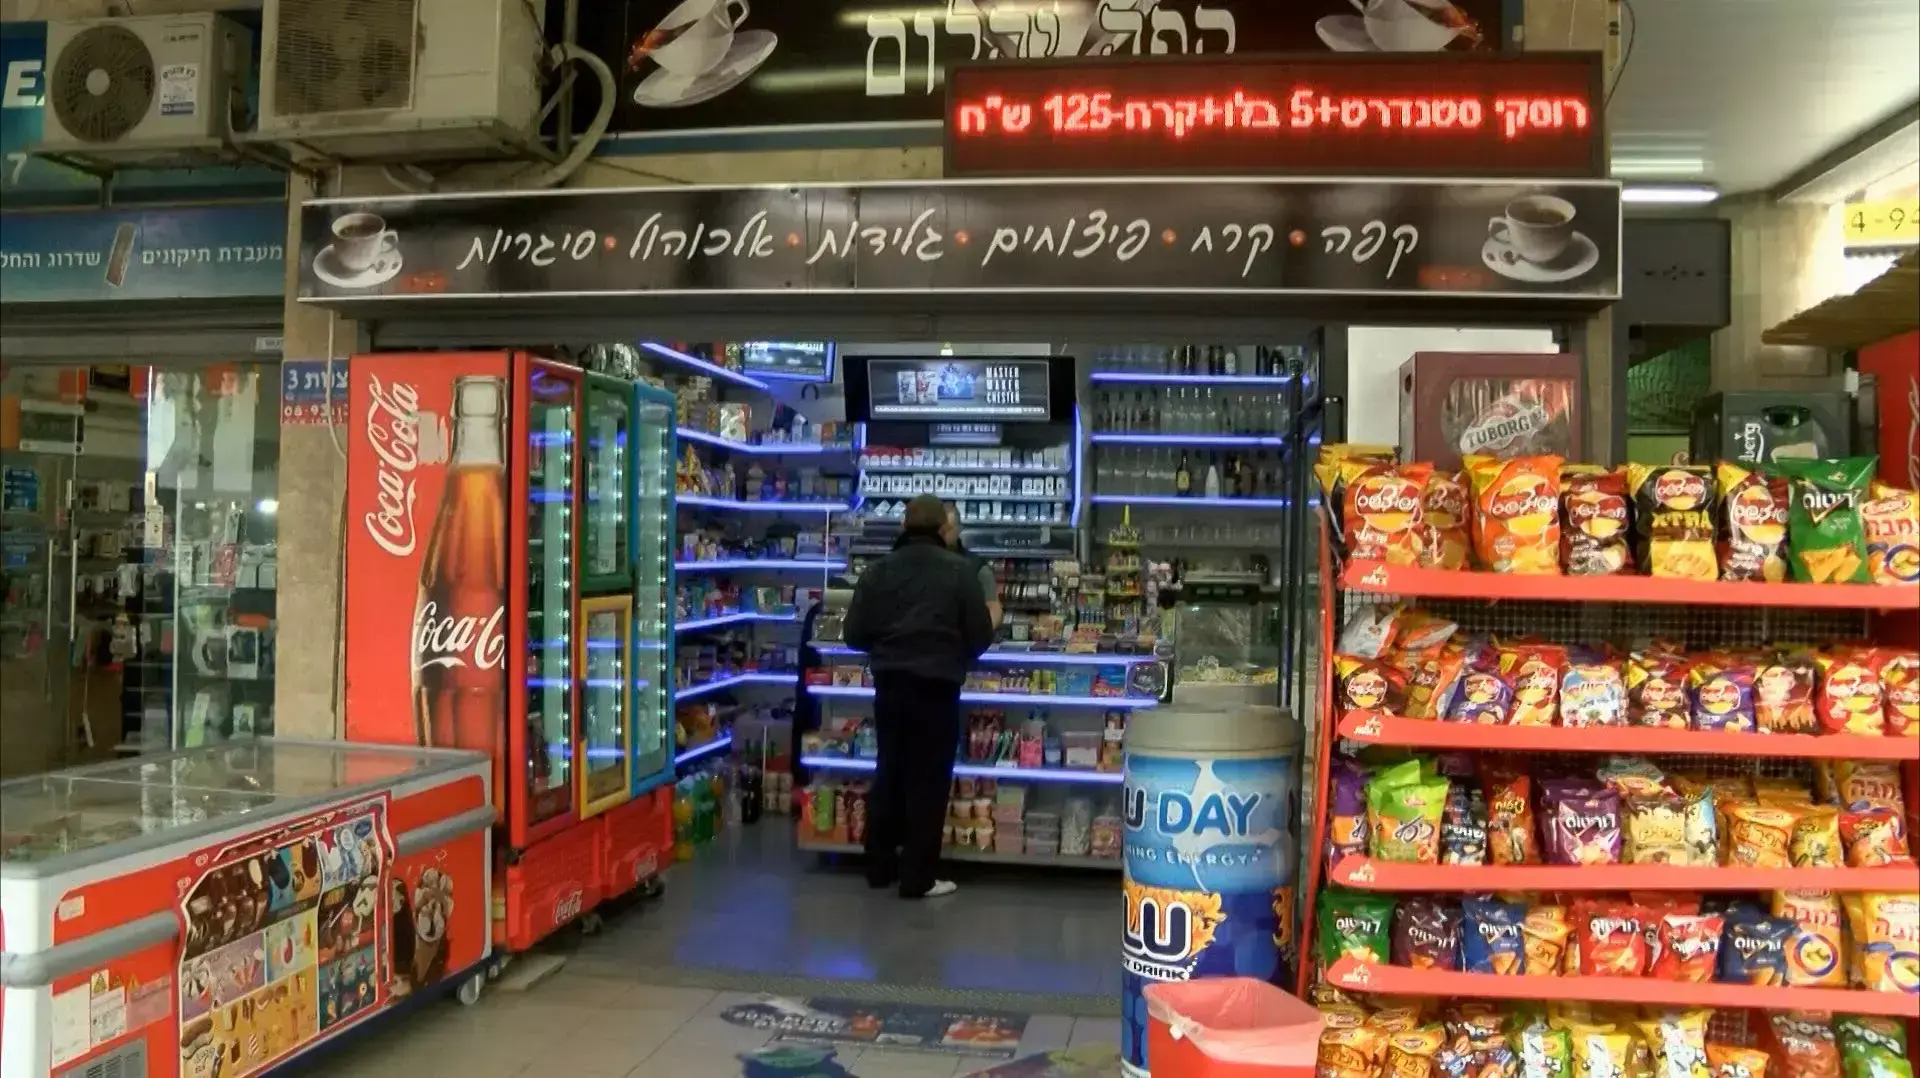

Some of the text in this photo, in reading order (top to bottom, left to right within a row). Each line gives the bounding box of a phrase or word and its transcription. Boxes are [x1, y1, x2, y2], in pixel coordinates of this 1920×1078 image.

[958, 94, 1033, 133] ש"ח
[1290, 89, 1483, 129] סטנדרט+5
[1495, 98, 1588, 138] רוסקי
[47, 250, 102, 269] שדרוג
[141, 245, 284, 270] מעבדת תיקונים
[455, 207, 1420, 280] קפה קרח פיצוחים גלידות אלכוהול סיגריות
[287, 368, 299, 390] 3
[1466, 411, 1532, 450] TUBORG
[364, 372, 419, 557] Coca-Cola
[413, 601, 505, 670] Coca-C
[1157, 790, 1262, 837] DAY
[1166, 850, 1248, 867] ENERGY
[1133, 963, 1185, 981] DRINK
